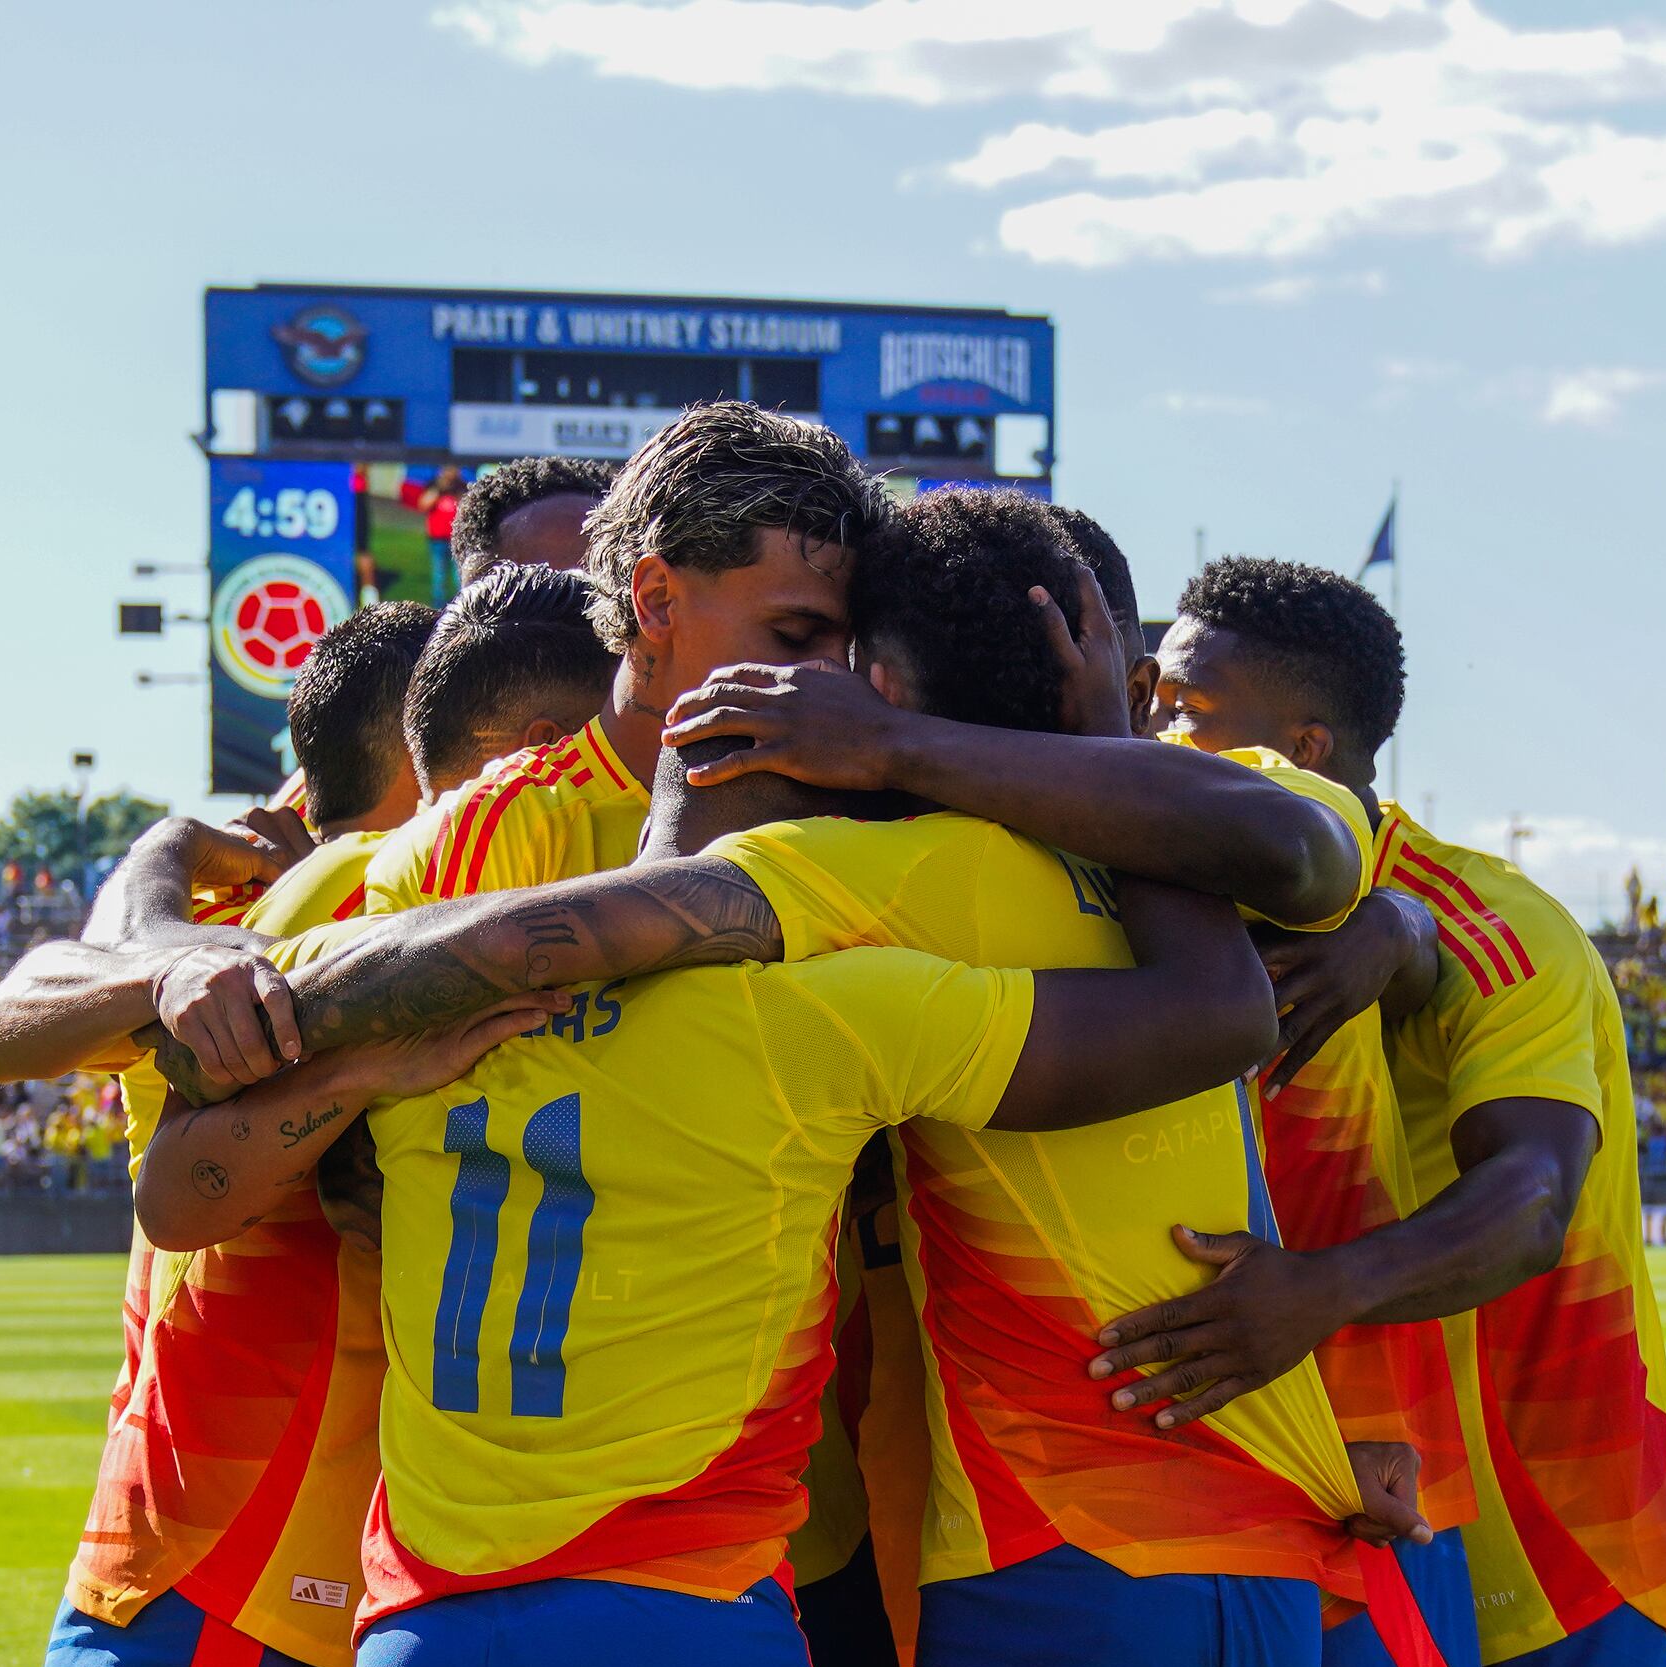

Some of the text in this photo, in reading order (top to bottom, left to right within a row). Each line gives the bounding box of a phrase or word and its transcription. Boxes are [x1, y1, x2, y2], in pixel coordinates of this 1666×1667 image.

[434, 304, 842, 354] PRATT & WHITNEY STADIUM
[222, 486, 339, 539] 4:59
[1123, 1109, 1243, 1164] CATAPU
[432, 1091, 595, 1418] 11
